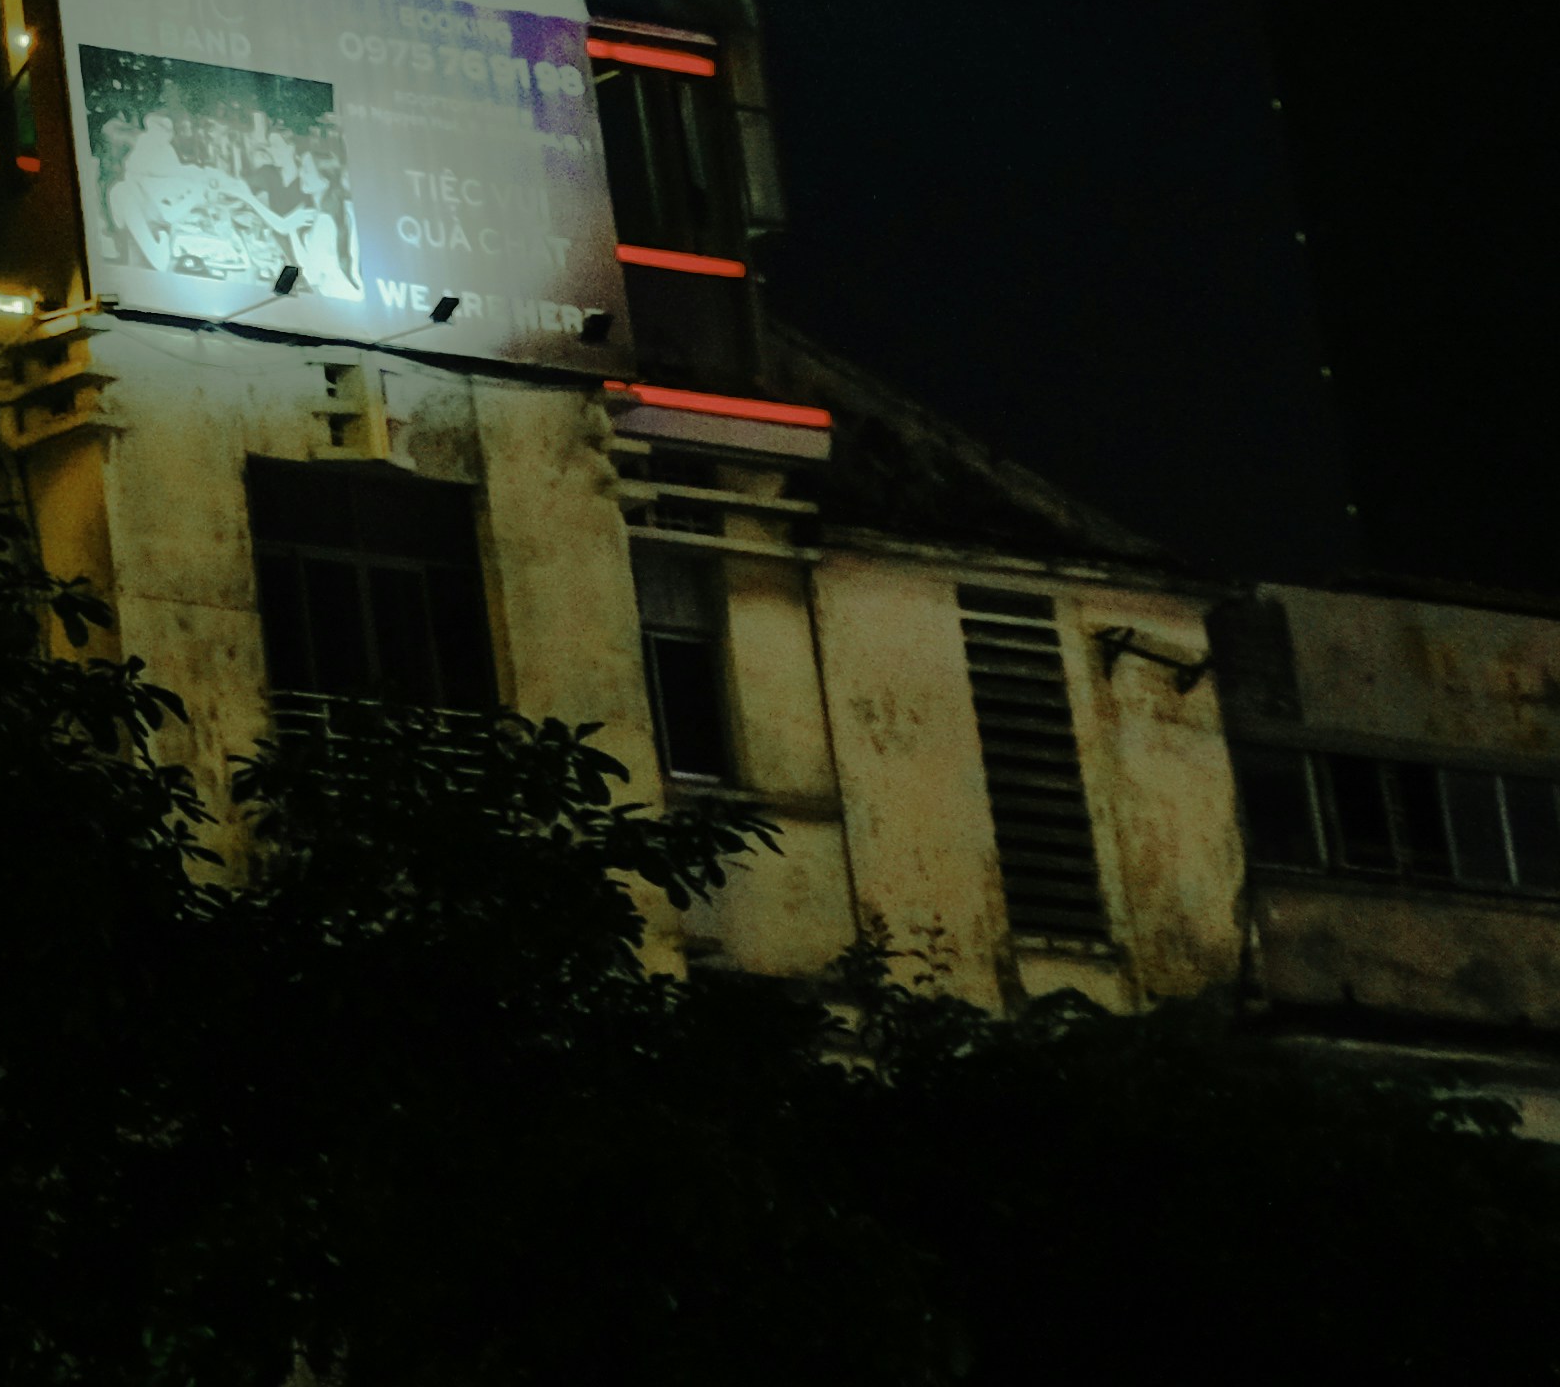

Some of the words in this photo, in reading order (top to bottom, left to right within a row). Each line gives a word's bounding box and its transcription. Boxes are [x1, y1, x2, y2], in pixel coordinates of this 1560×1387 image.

[337, 30, 436, 73] 0975
[437, 44, 488, 81] 76
[376, 277, 432, 314] WE
[514, 299, 609, 335] HER
